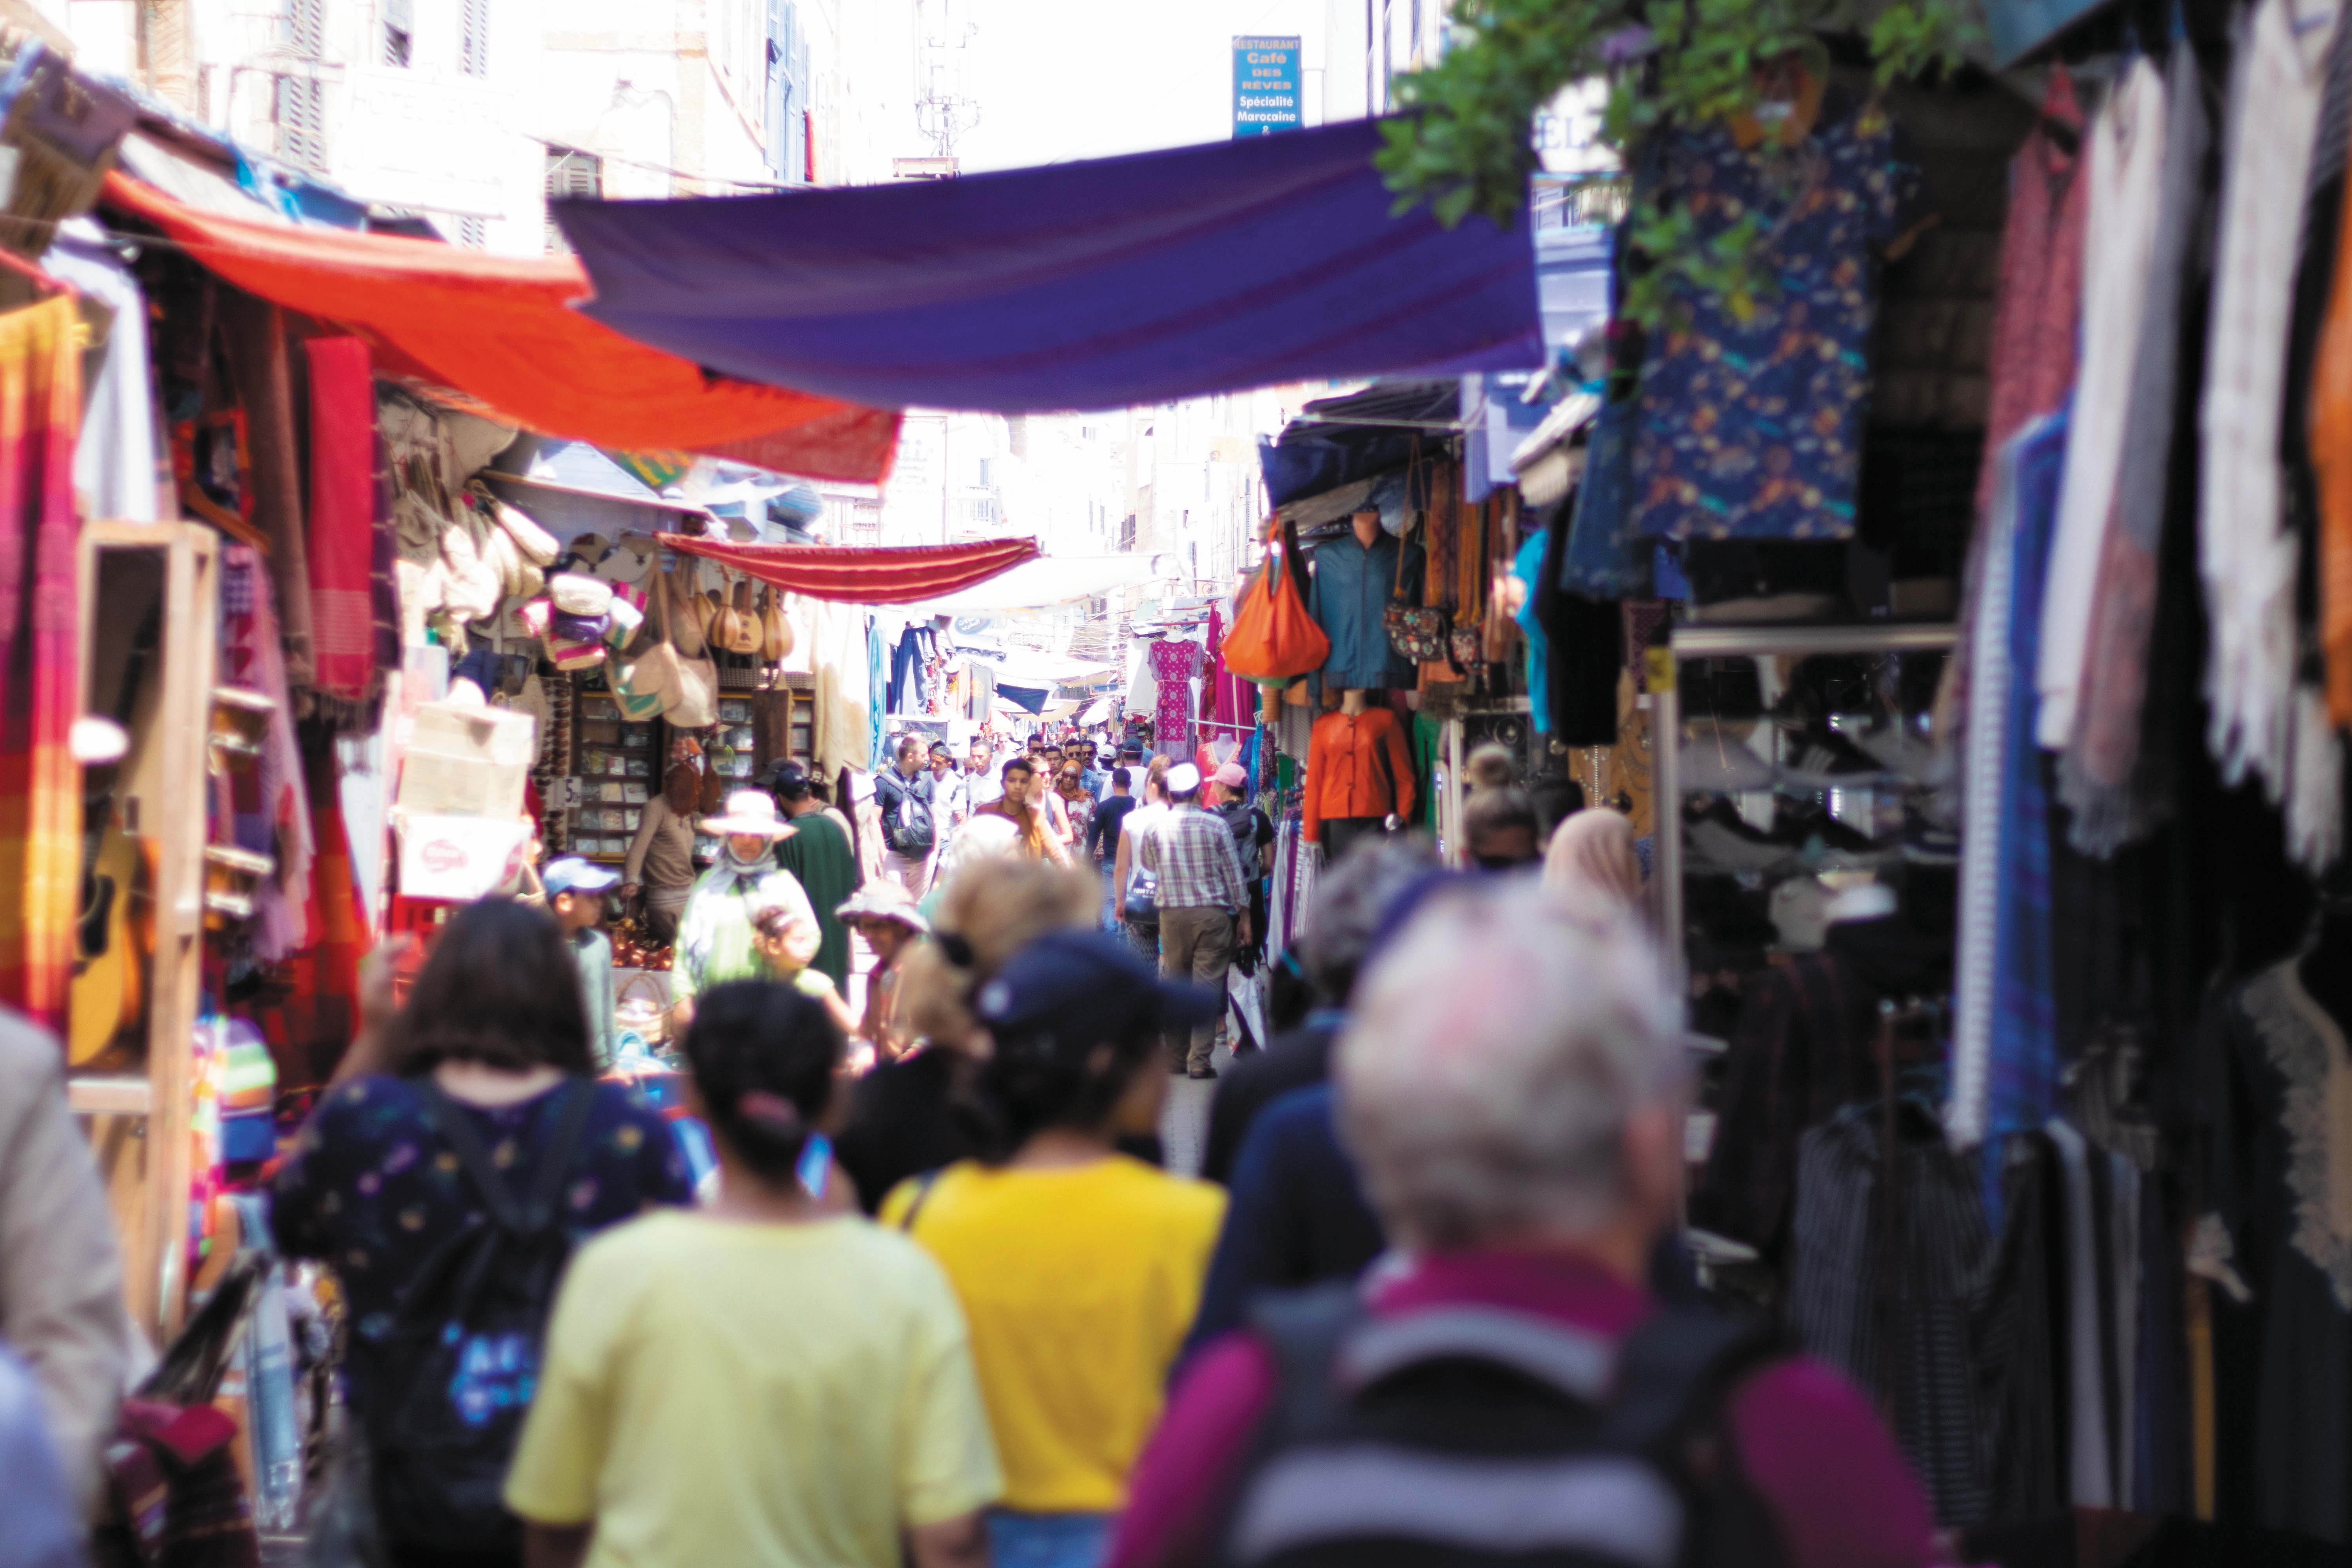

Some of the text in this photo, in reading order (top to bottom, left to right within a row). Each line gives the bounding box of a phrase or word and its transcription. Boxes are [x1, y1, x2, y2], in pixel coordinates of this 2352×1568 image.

[1234, 40, 1299, 49] RESTAURANT
[1247, 52, 1287, 64] Café
[1252, 68, 1282, 77] DES
[1240, 96, 1293, 109] Spécialité
[1237, 110, 1296, 122] Marocaine
[565, 779, 573, 803] 5
